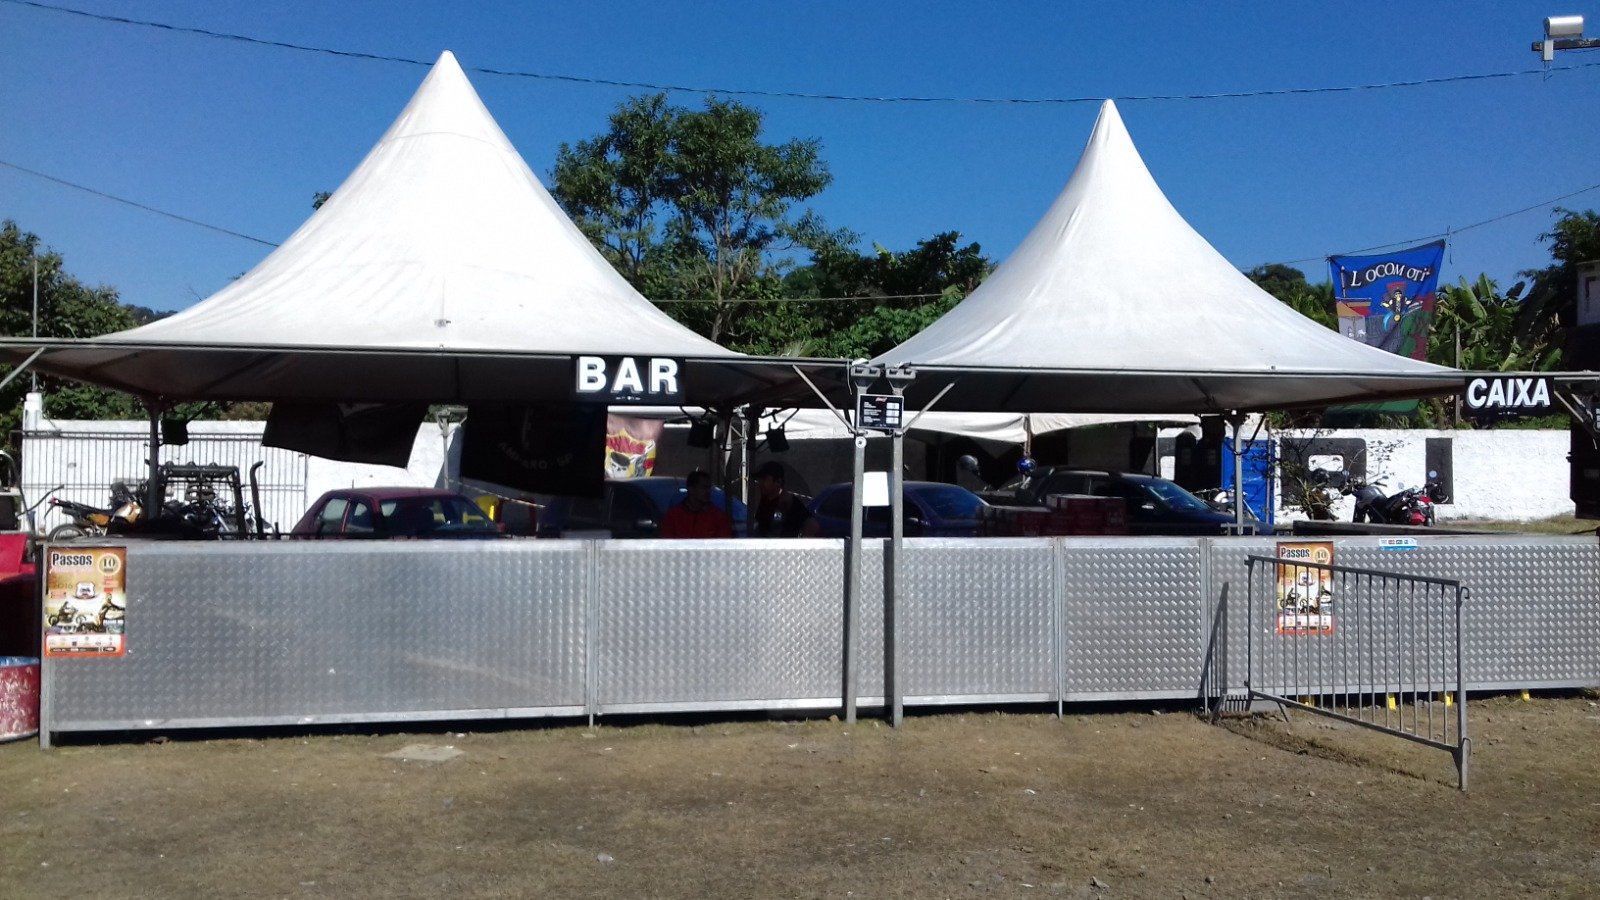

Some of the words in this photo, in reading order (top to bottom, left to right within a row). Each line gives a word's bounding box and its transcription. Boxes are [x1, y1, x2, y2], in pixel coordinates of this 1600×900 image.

[1350, 262, 1431, 287] LOCOMOTi
[576, 356, 678, 394] BAR
[1467, 378, 1550, 408] CAIXA
[1281, 547, 1310, 558] Passos
[1316, 551, 1327, 559] 10
[52, 553, 92, 566] Passos
[103, 558, 116, 567] 10
